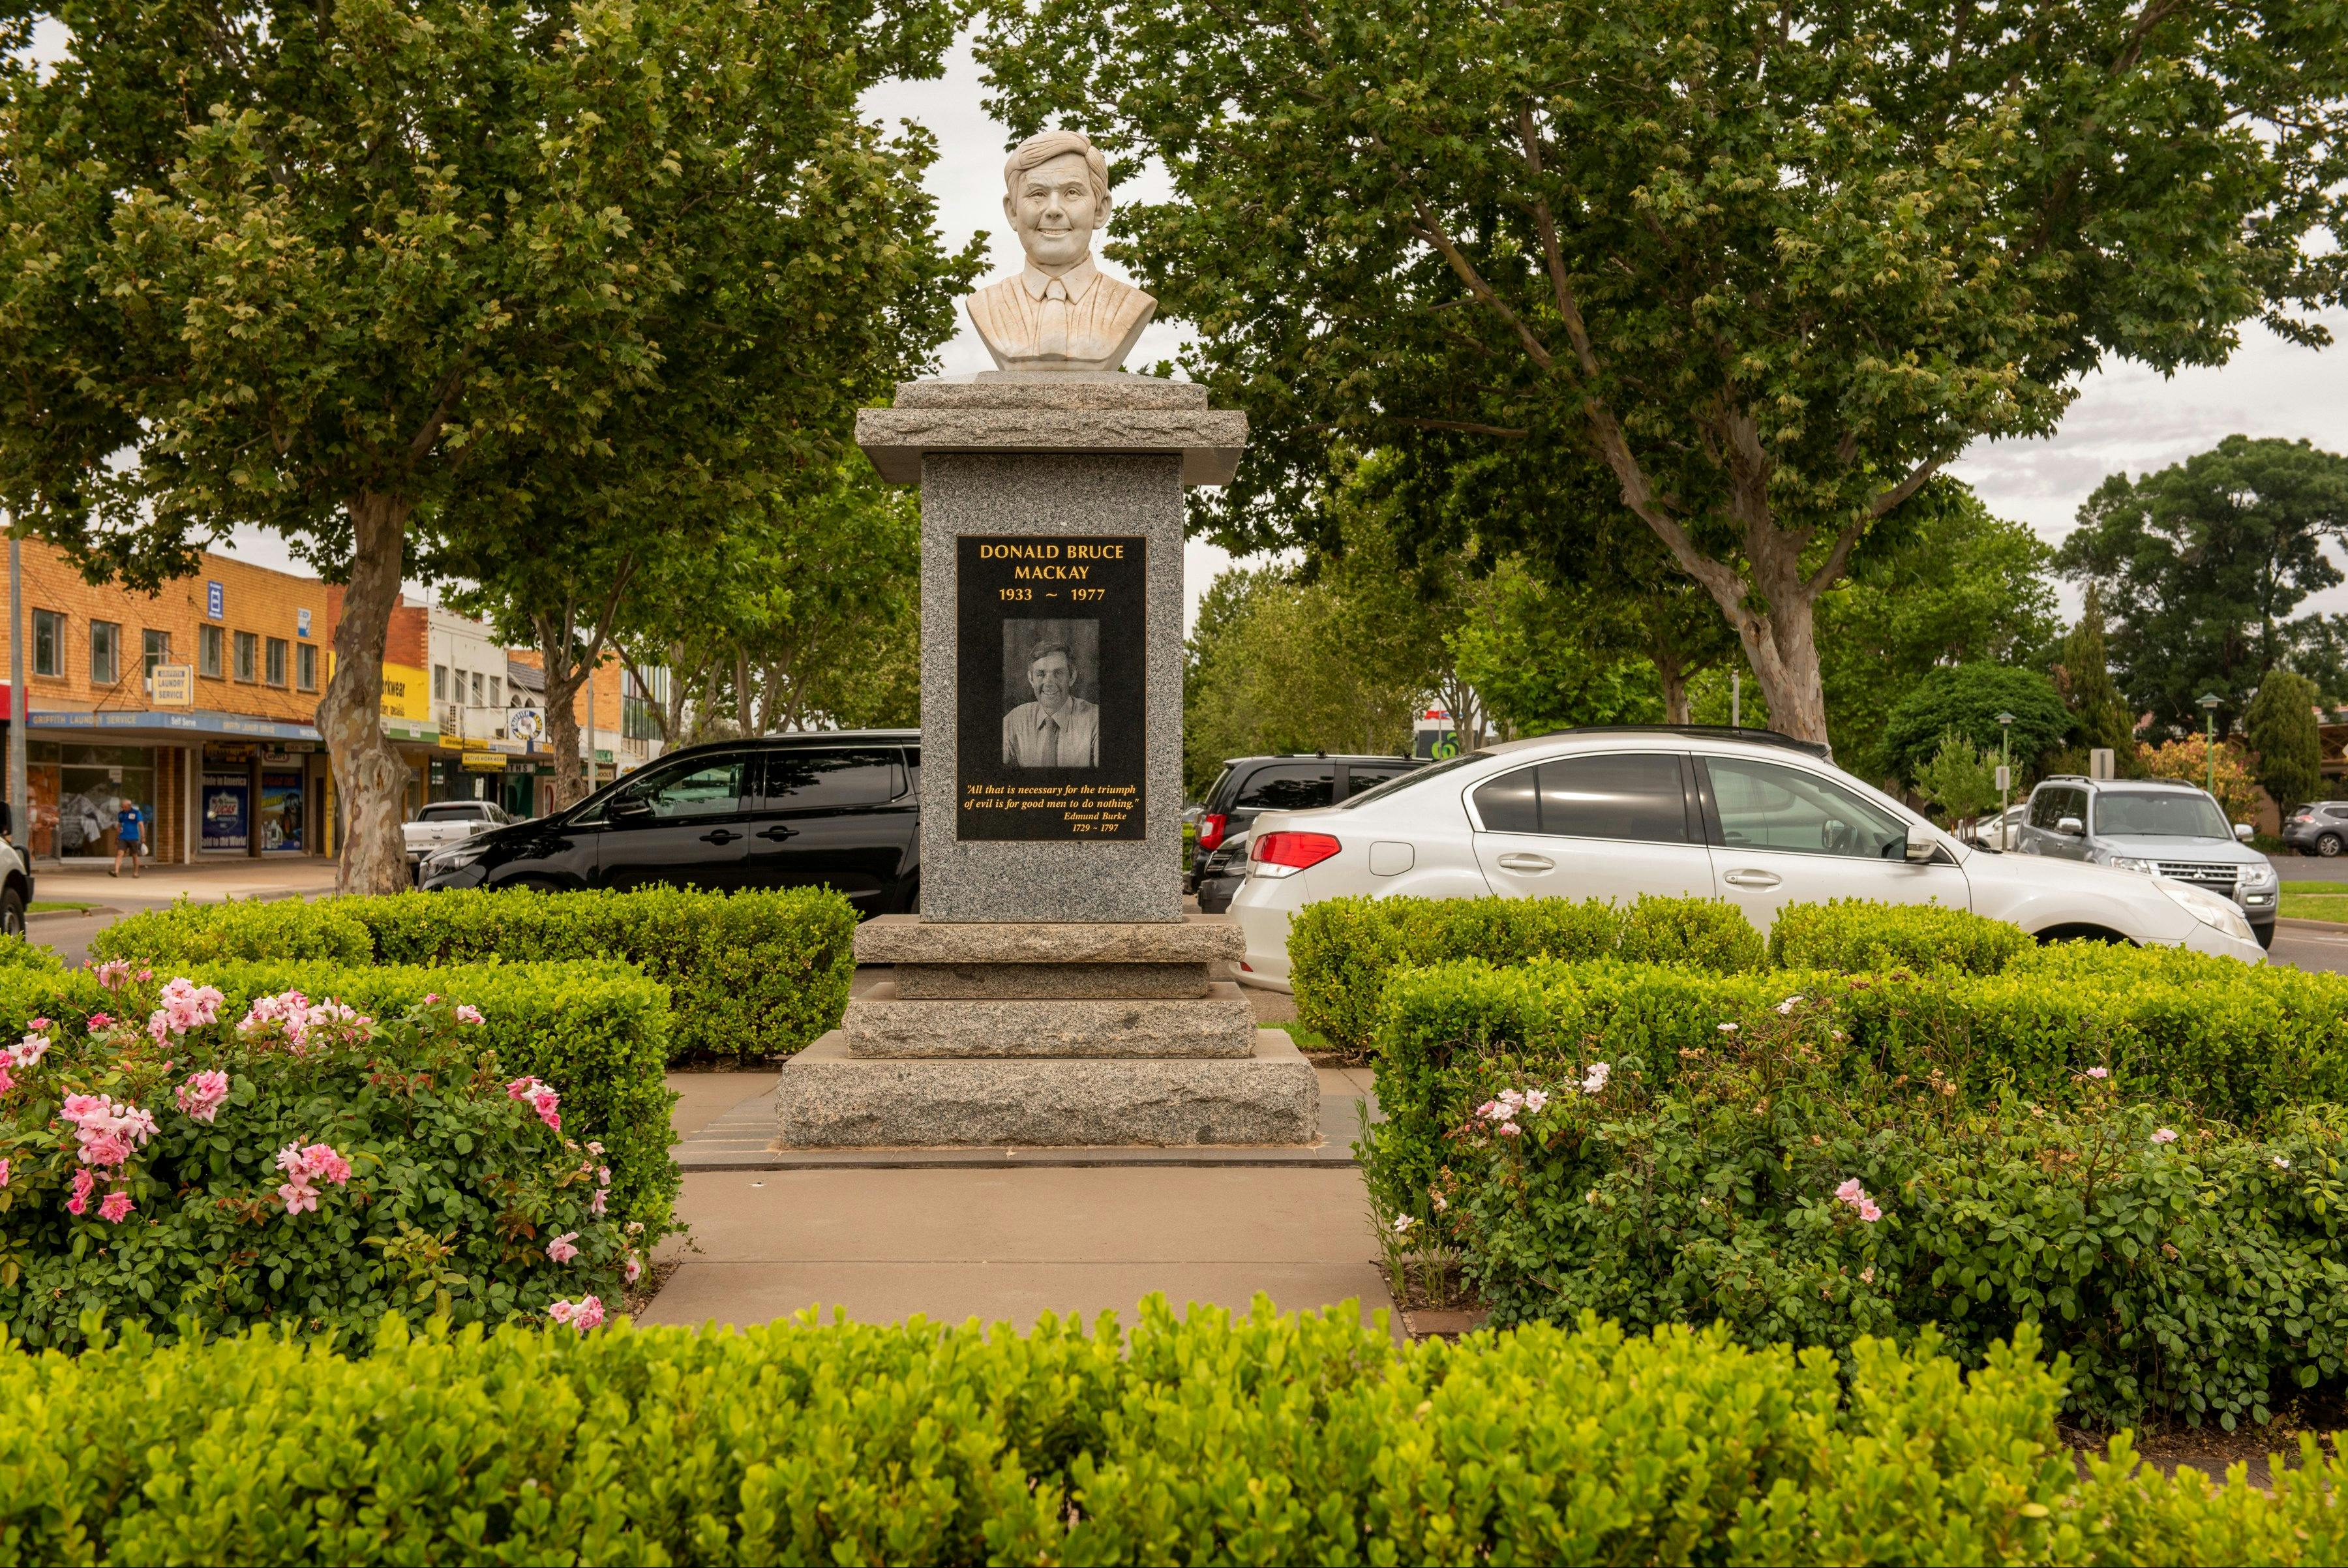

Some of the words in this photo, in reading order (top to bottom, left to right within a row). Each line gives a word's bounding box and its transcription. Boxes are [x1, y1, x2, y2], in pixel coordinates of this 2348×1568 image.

[980, 545, 1059, 559] DONALD
[1067, 545, 1124, 559] BRUCE
[1014, 565, 1090, 579] MACKAY
[999, 588, 1032, 601] 1933
[1071, 588, 1106, 601] 1977
[33, 715, 66, 724] GRIFFITH
[70, 716, 102, 725] LAUNDY
[106, 716, 136, 724] SERVICE
[171, 716, 181, 725] Self
[224, 776, 247, 787] America
[967, 785, 982, 794] "All
[985, 785, 1004, 794] that
[1007, 785, 1016, 794] is
[1018, 787, 1062, 796] necessary
[1063, 785, 1078, 796] for
[1080, 785, 1095, 794] the
[1098, 785, 1136, 796] triumph
[964, 799, 975, 810] of
[976, 799, 993, 807] evil
[995, 799, 1004, 807] is
[1004, 799, 1019, 810] for
[1021, 799, 1045, 810] good
[1081, 799, 1094, 807] do
[1096, 798, 1139, 810] nothing."
[230, 836, 247, 847] World
